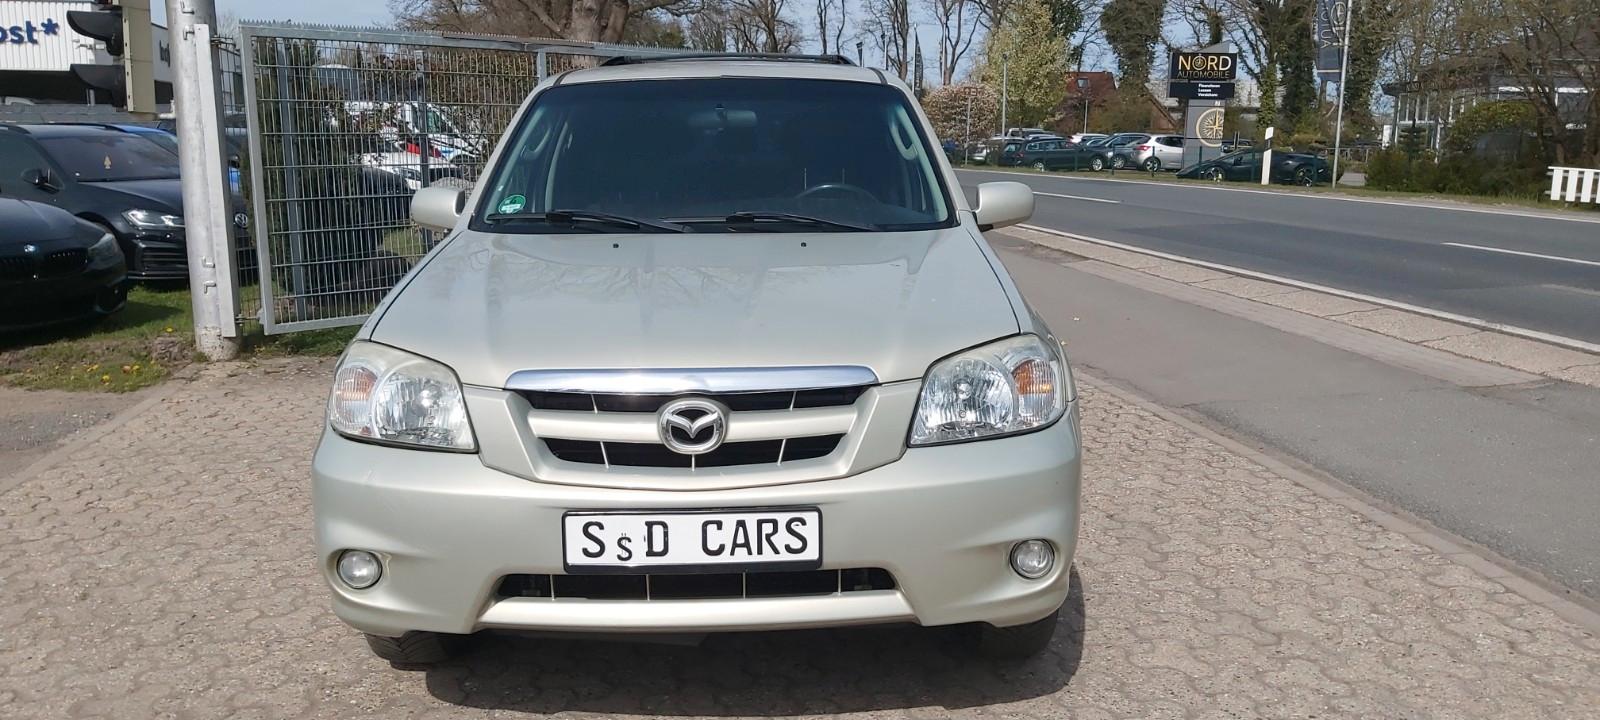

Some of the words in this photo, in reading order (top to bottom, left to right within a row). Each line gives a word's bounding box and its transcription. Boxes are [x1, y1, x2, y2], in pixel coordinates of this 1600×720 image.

[1178, 54, 1232, 71] NORD
[1177, 70, 1231, 79] AUTOMOBILE
[701, 517, 808, 556] CARS
